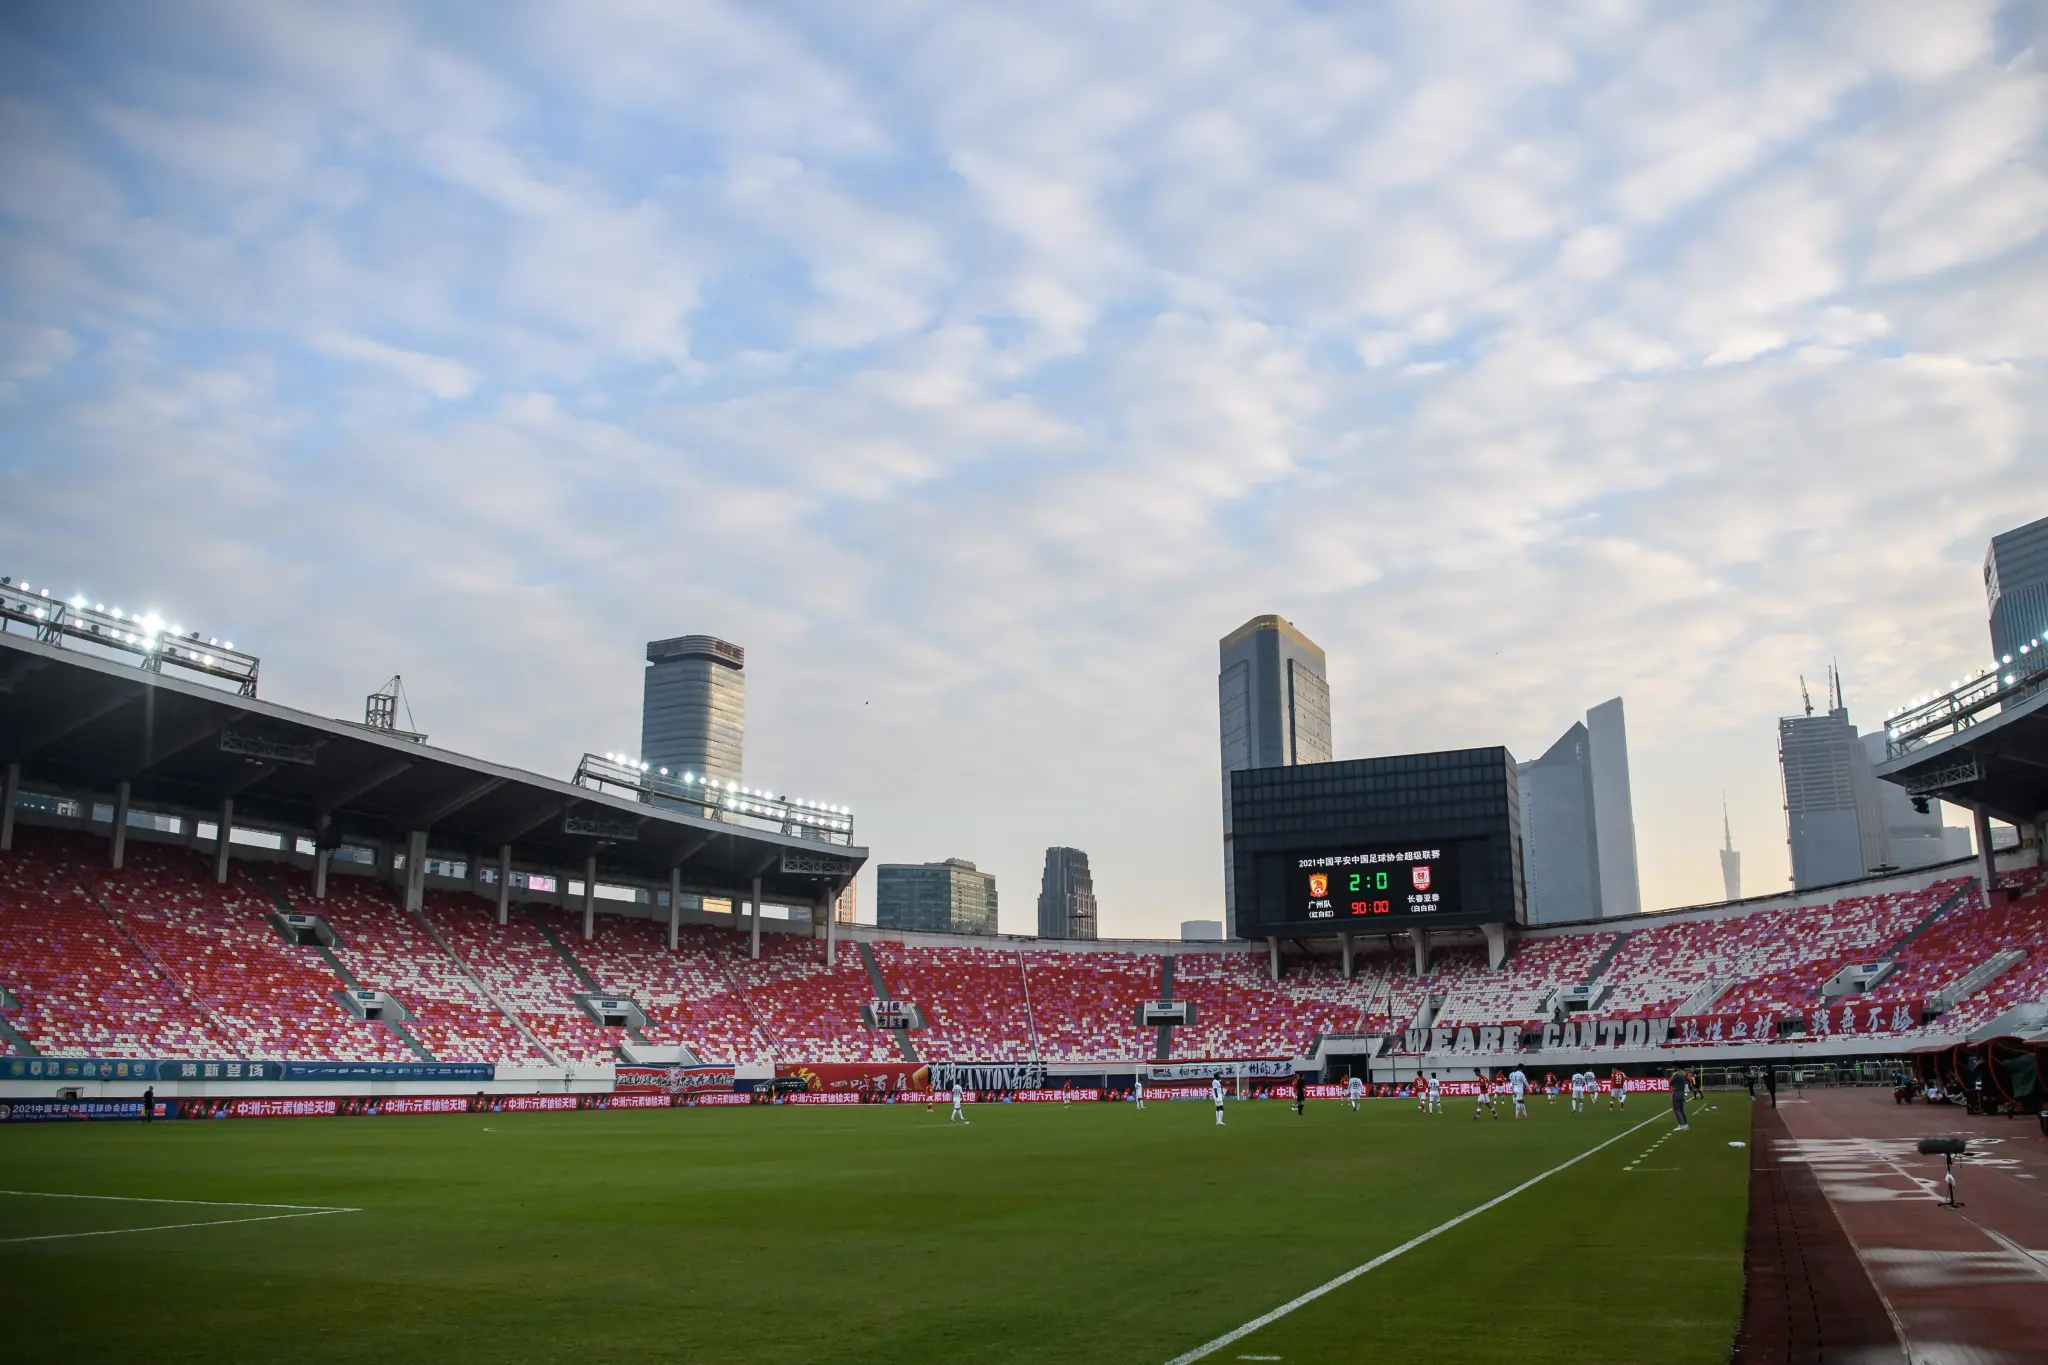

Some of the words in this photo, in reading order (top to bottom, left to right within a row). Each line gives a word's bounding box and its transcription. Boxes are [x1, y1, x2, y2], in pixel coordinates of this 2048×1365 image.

[1299, 850, 1440, 867] 2021中国平安中国足球协会超级联赛
[1308, 900, 1332, 909] 广州队
[1407, 893, 1440, 903] 长春亚泰
[1351, 900, 1389, 914] 90:00
[1541, 1019, 1670, 1048] CANTON
[181, 1063, 264, 1077] 焕新登场
[237, 1101, 336, 1116] 中洲六元素体验天地
[385, 1099, 467, 1112] 中洲六元素体验天地
